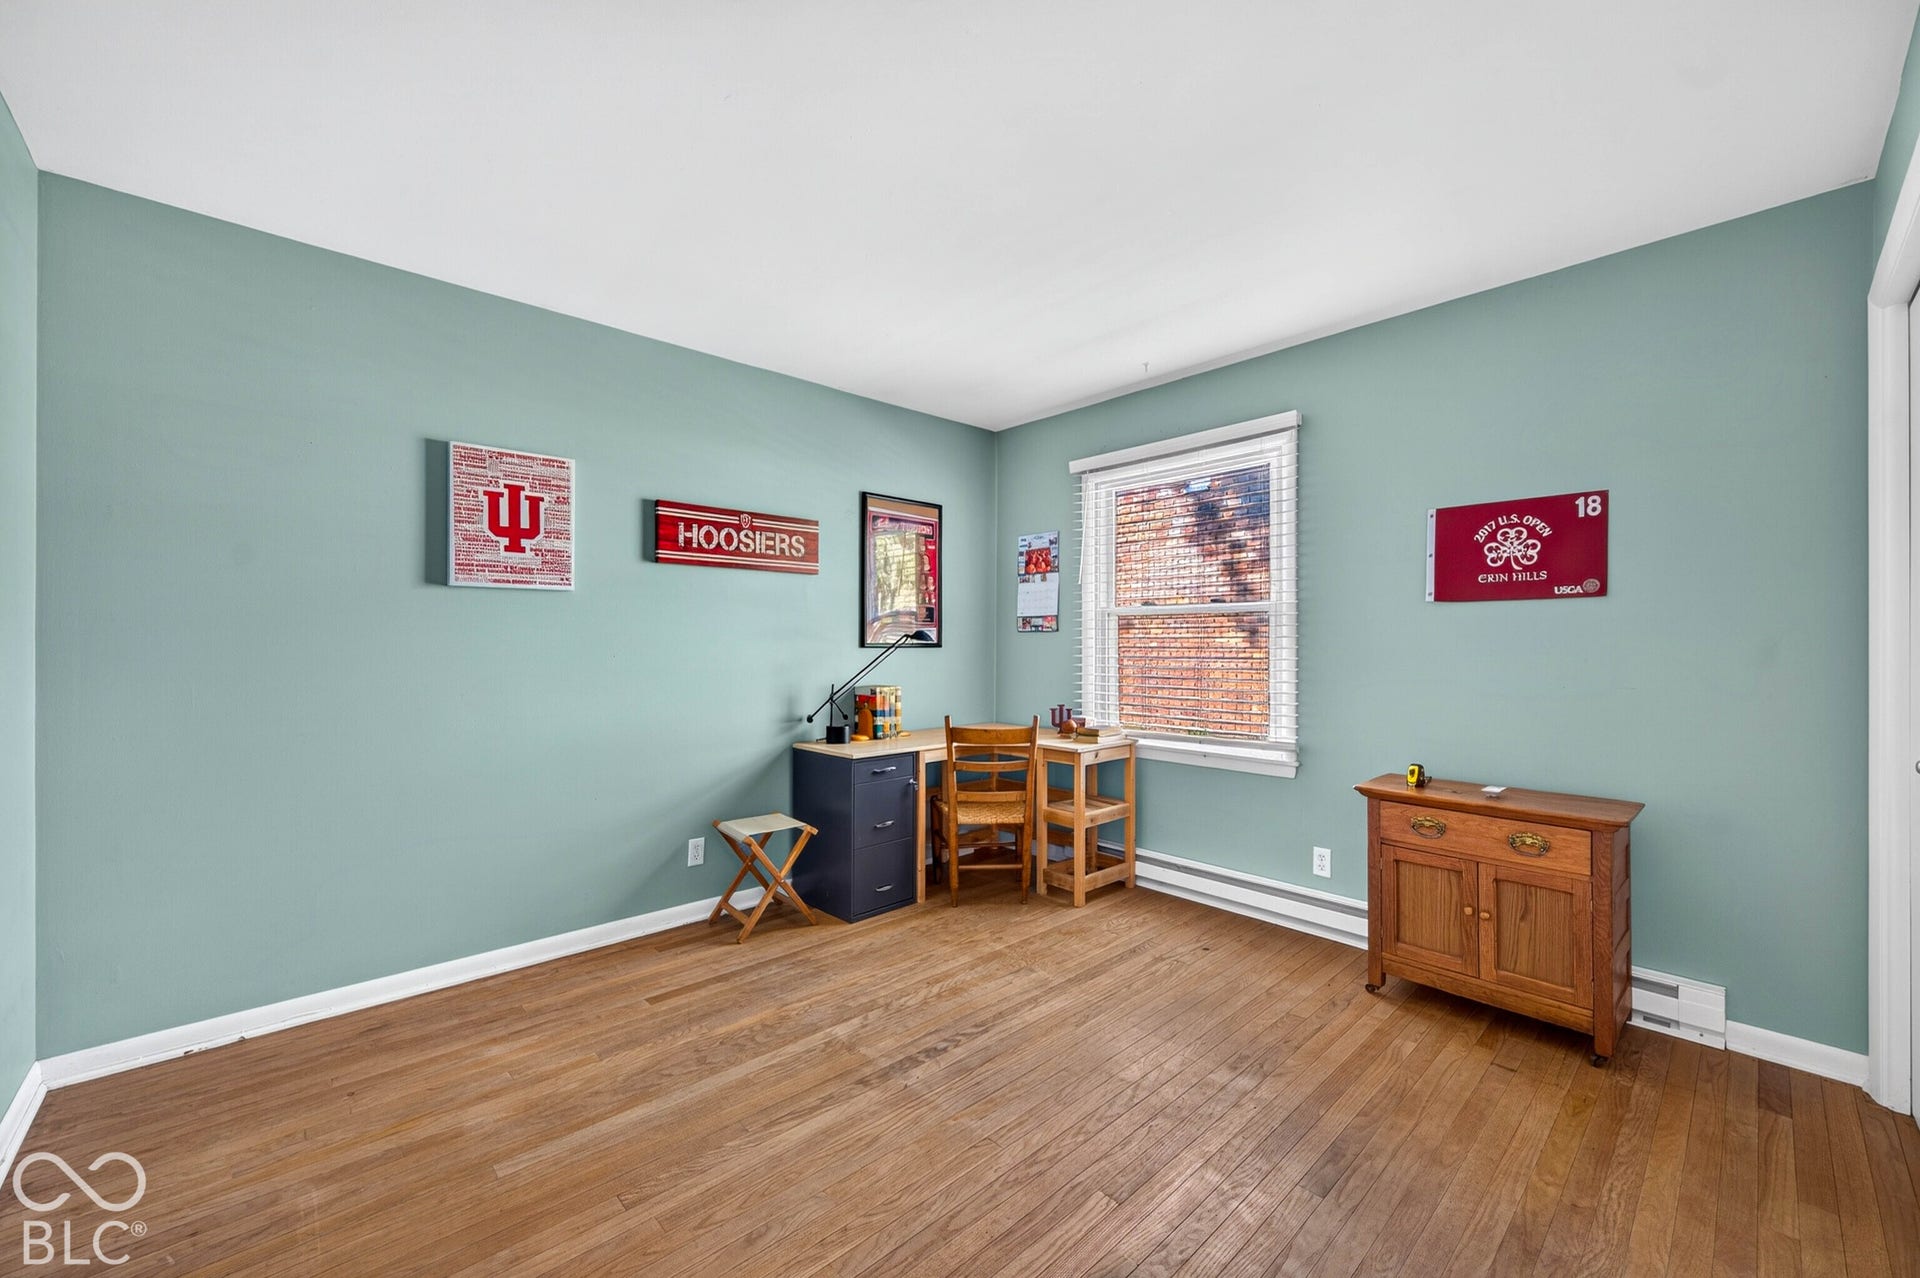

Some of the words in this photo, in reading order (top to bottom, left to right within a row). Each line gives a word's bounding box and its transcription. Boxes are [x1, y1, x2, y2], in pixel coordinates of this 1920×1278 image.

[1575, 495, 1602, 518] 18
[678, 521, 805, 558] HOOSIERS
[1473, 520, 1496, 543] 2017
[1522, 515, 1553, 538] OPEN
[1477, 573, 1509, 584] ERIN
[1512, 570, 1548, 583] HILLS
[1554, 586, 1584, 595] USGA
